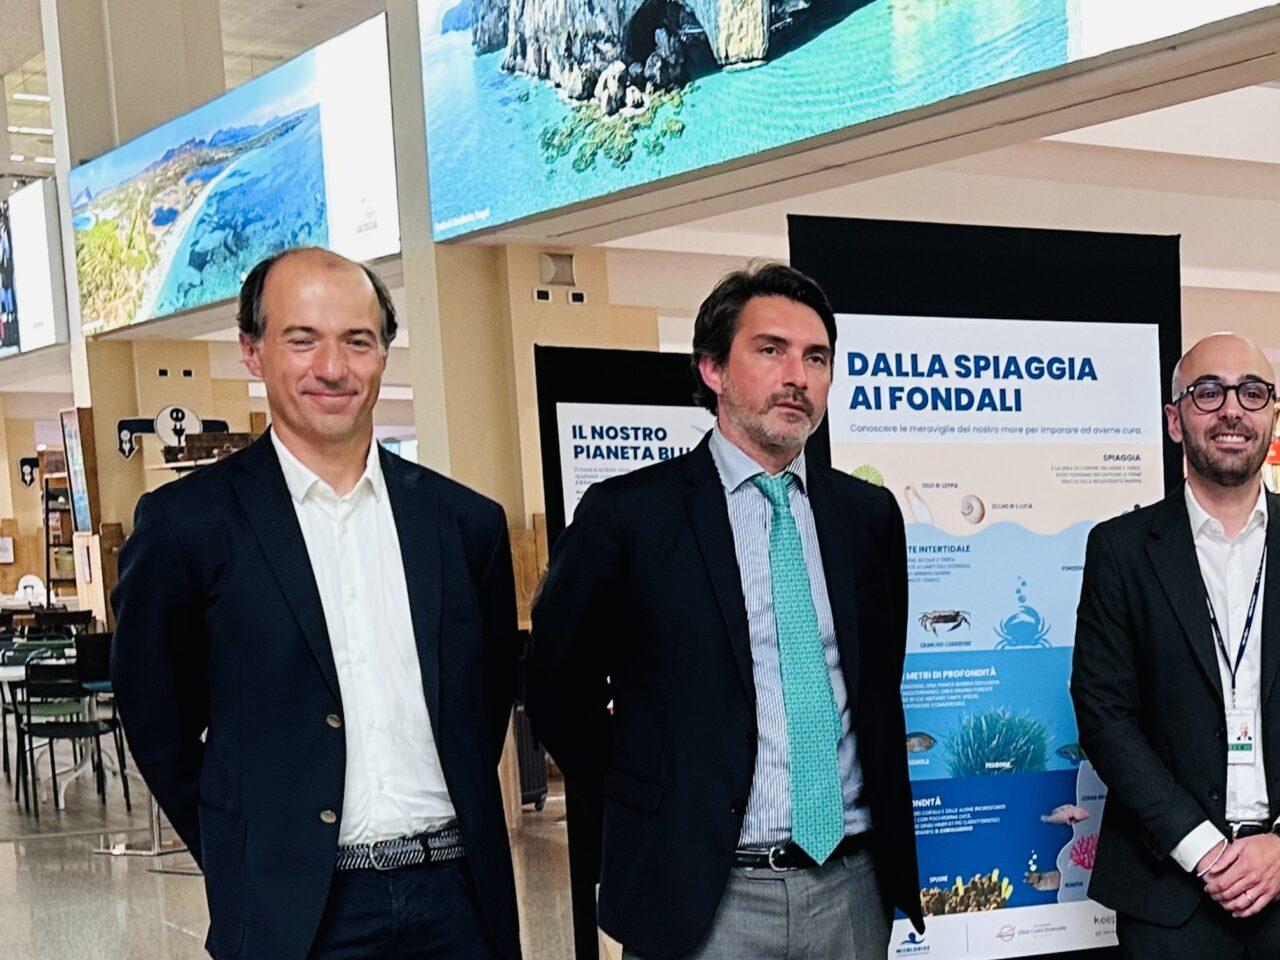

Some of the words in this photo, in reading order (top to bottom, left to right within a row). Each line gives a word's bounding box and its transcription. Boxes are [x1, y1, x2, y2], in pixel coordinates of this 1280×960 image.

[847, 352, 948, 378] DALLA
[955, 355, 1098, 381] SPIAGGIA
[849, 386, 883, 410] AI
[890, 386, 1022, 412] FONDALI
[572, 425, 587, 439] IL
[591, 426, 667, 441] NOSTRO
[849, 423, 898, 433] Conoscere
[899, 424, 907, 432] le
[909, 424, 955, 435] meraviglie
[972, 425, 999, 434] nostro
[1025, 426, 1039, 436] per
[1040, 426, 1079, 436] imparare
[1080, 425, 1091, 433] ad
[573, 445, 655, 460] PIANETA
[1103, 454, 1141, 462] SPIAGGIA
[919, 544, 971, 553] INTERTIDALE
[906, 670, 931, 681] METRI
[933, 669, 941, 679] DI
[943, 666, 996, 679] PROFONDITÀ
